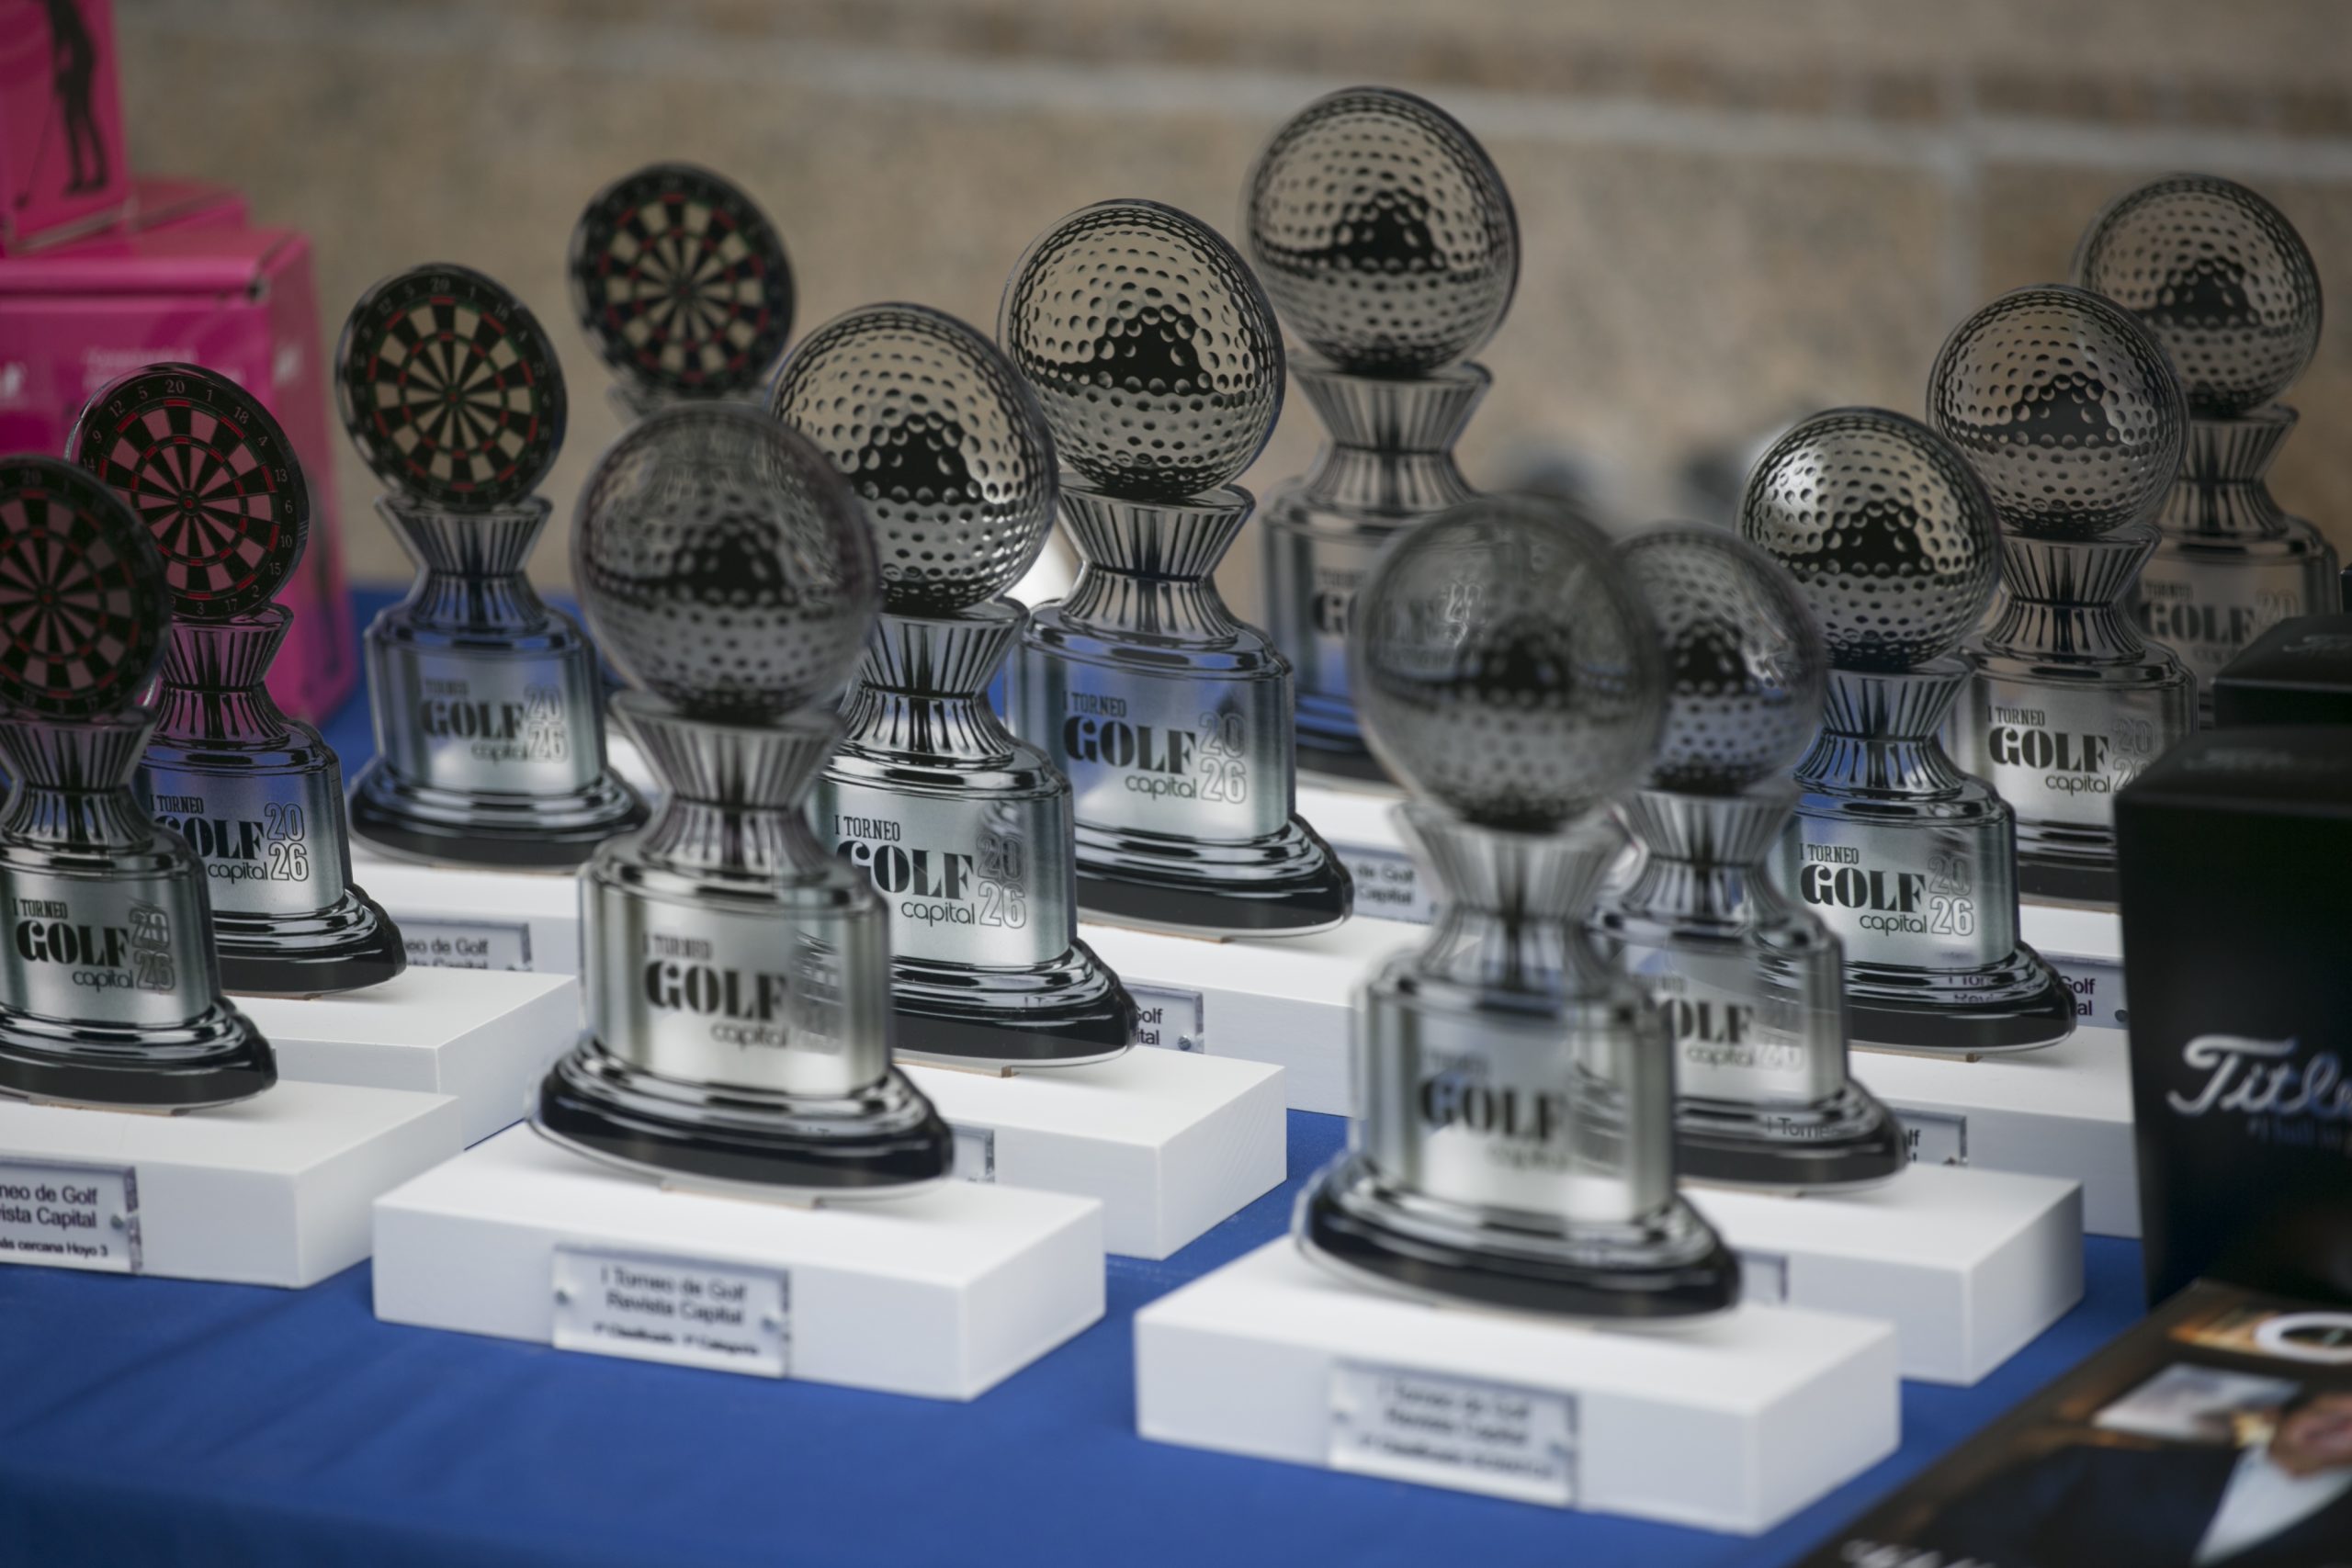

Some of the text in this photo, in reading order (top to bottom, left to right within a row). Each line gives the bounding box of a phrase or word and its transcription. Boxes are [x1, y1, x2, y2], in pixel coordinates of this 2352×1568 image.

[139, 387, 148, 400] 5
[165, 380, 185, 394] 20
[206, 389, 213, 401] 1
[108, 401, 126, 418] 12
[233, 406, 249, 424] 18
[93, 431, 102, 443] 9
[257, 435, 268, 447] 4
[275, 469, 288, 481] 13
[285, 501, 293, 513] 6
[280, 535, 292, 547] 10
[269, 562, 281, 576] 15
[252, 585, 259, 598] 2
[197, 603, 205, 615] 3
[224, 599, 238, 612] 17
[2139, 602, 2256, 643] GOLF
[525, 683, 565, 721] 20
[1072, 693, 1127, 717] TORNEO
[420, 700, 525, 739] GOLF
[1996, 706, 2045, 727] TORNEO
[1064, 716, 1196, 775] GOLF
[1199, 712, 1246, 759] 20
[2114, 718, 2154, 756] 20
[1989, 727, 2109, 773] GOLF
[1125, 774, 1197, 800] capital
[1201, 757, 1247, 804] 26
[2045, 774, 2110, 796] capital
[157, 795, 204, 814] TORNEO
[265, 803, 305, 841] 20
[835, 815, 900, 841] I TORNEO
[269, 842, 310, 881] 26
[977, 831, 1023, 882] 20
[1799, 843, 1859, 865] I TORNEO
[208, 862, 268, 885] capital
[1928, 855, 1972, 896] 20
[1801, 863, 1926, 913] GOLF
[13, 898, 68, 919] I TORNEO
[901, 901, 975, 927] capital
[978, 881, 1026, 929] 26
[1930, 896, 1974, 936] 26
[129, 907, 170, 950] 20
[1860, 914, 1928, 937] capital
[16, 920, 130, 967] GOLF
[72, 969, 134, 992] capital
[133, 950, 175, 991] 26
[647, 961, 786, 1021] GOLF
[710, 1023, 787, 1050] capital
[35, 1183, 57, 1202] de
[62, 1185, 97, 1205] Golf
[37, 1206, 96, 1231] Capital
